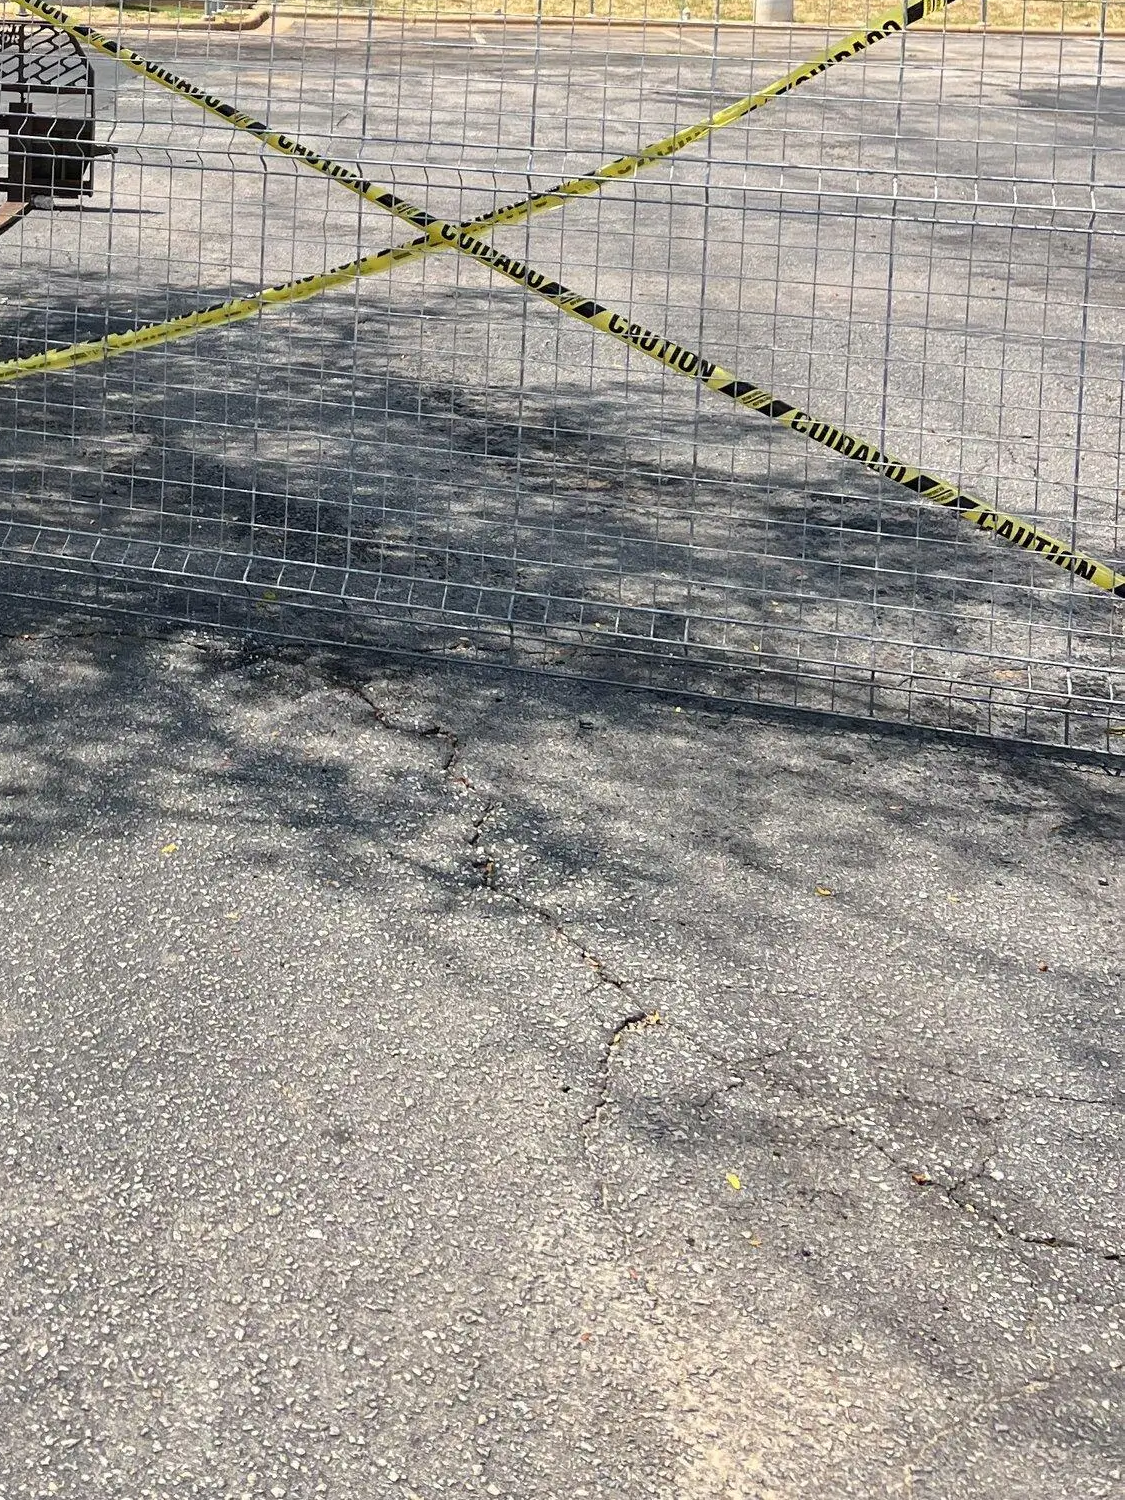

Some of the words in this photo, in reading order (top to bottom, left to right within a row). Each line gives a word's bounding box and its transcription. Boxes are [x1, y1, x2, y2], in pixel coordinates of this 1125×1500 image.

[277, 135, 372, 194] CAUTION
[441, 223, 545, 288] CUIDADO
[608, 313, 717, 383] CAUTION
[791, 411, 907, 481] CUIDADO
[976, 510, 1097, 581] CAUTION
